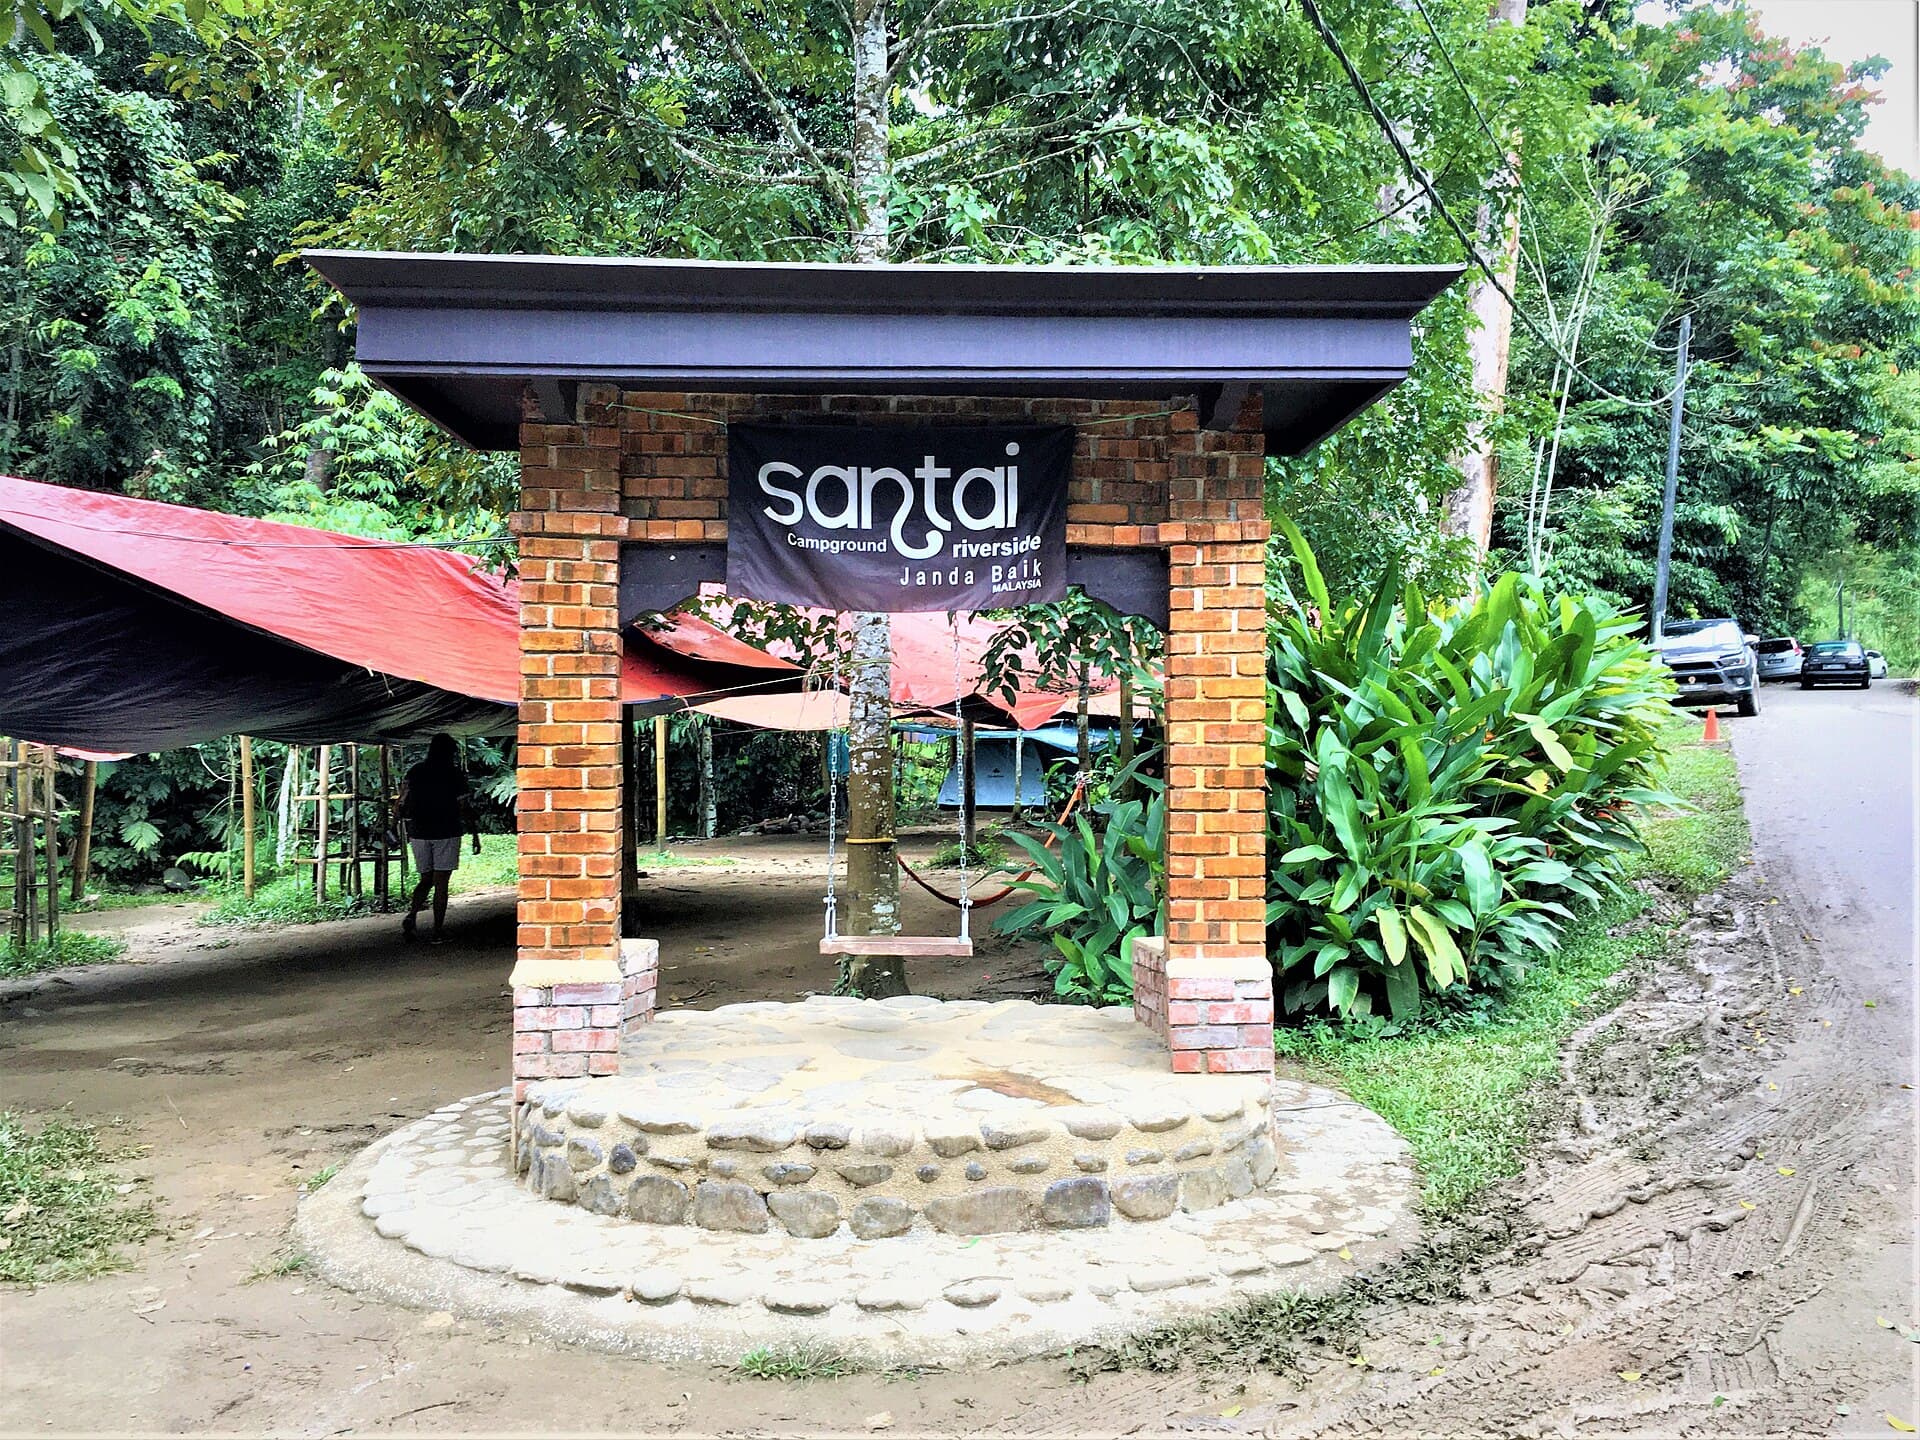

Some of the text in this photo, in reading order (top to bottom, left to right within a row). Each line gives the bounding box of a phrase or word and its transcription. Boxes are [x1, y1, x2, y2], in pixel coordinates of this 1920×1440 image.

[757, 441, 1020, 560] santai
[787, 532, 1042, 558] Campground riverside
[900, 559, 1042, 586] Janda Baik
[992, 579, 1042, 593] MALAYSIA
